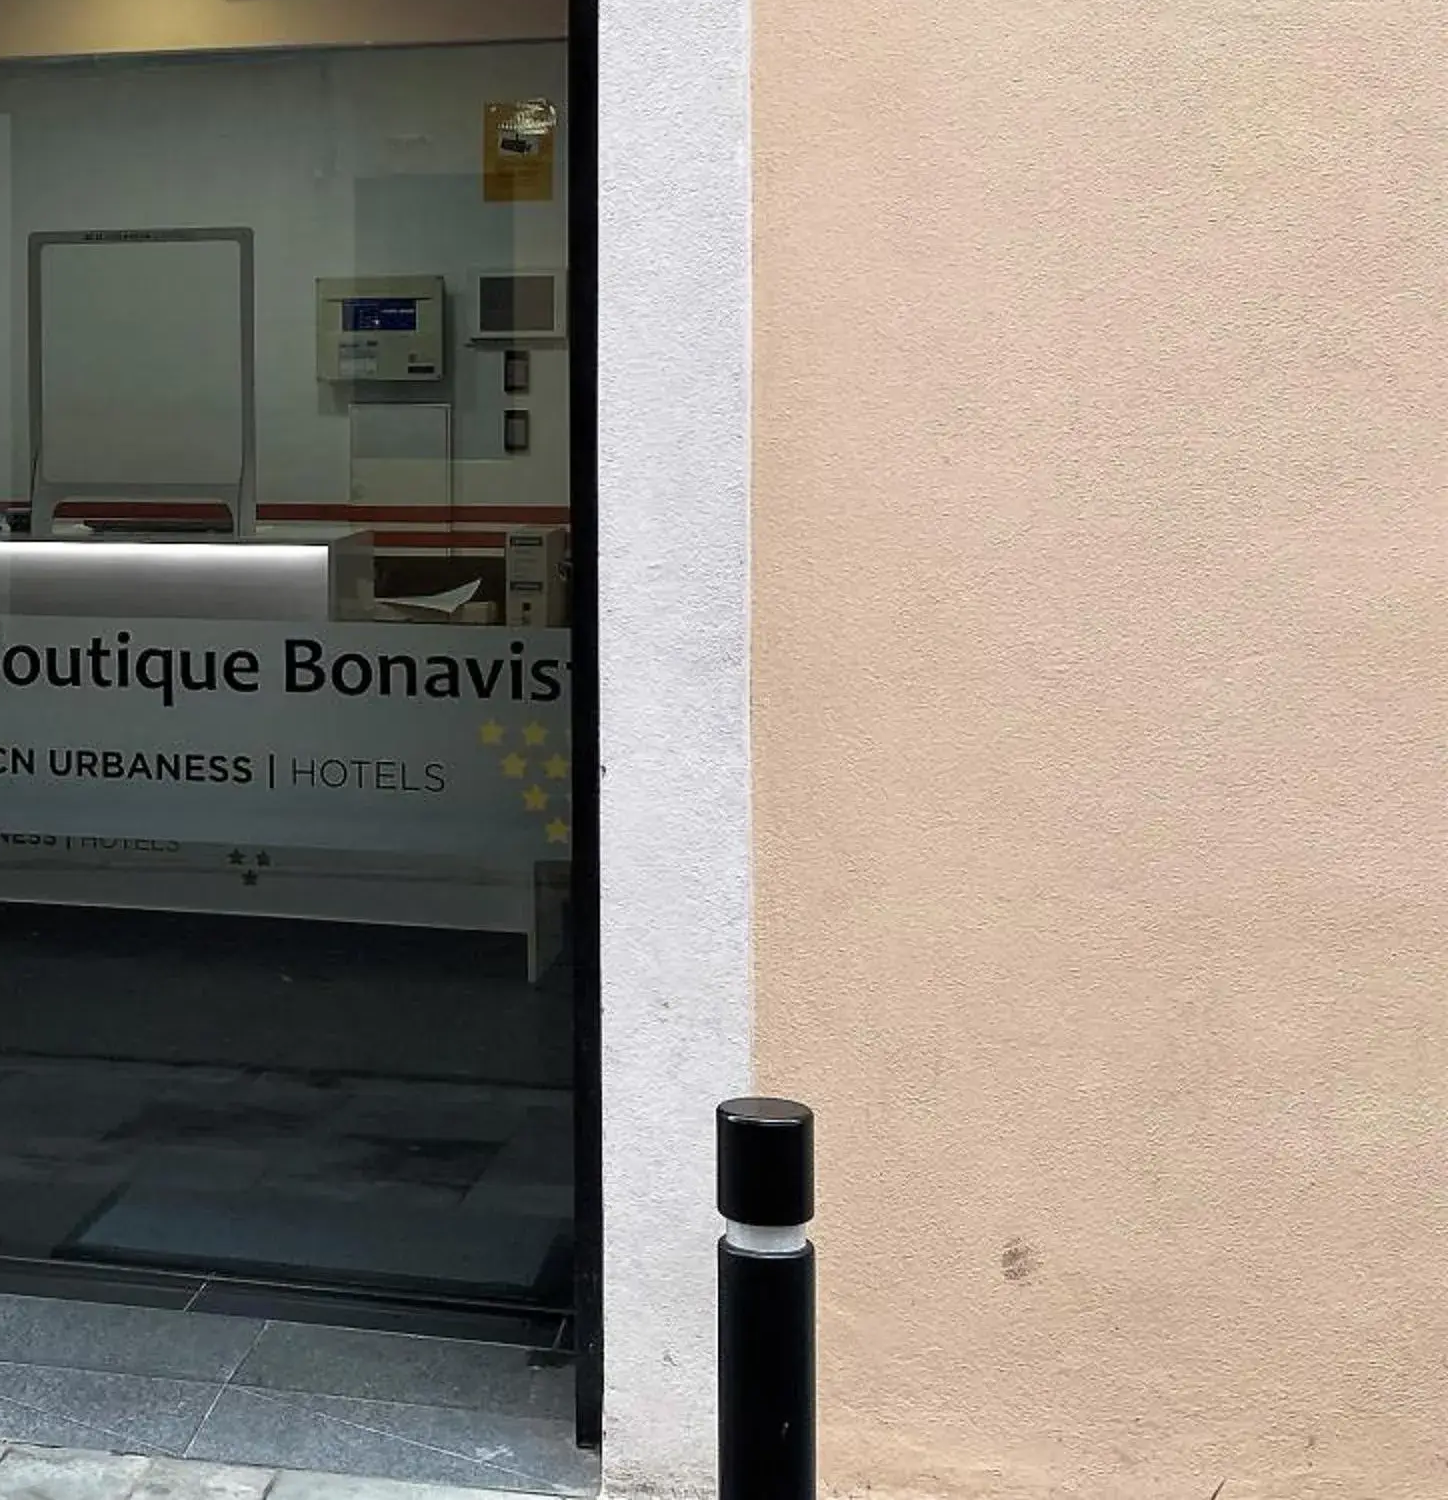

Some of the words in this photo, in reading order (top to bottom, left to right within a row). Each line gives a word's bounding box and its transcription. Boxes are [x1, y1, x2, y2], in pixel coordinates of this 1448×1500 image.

[285, 639, 571, 702] Bonavis
[49, 749, 253, 784] URBANESS
[292, 759, 445, 793] HOTELS
